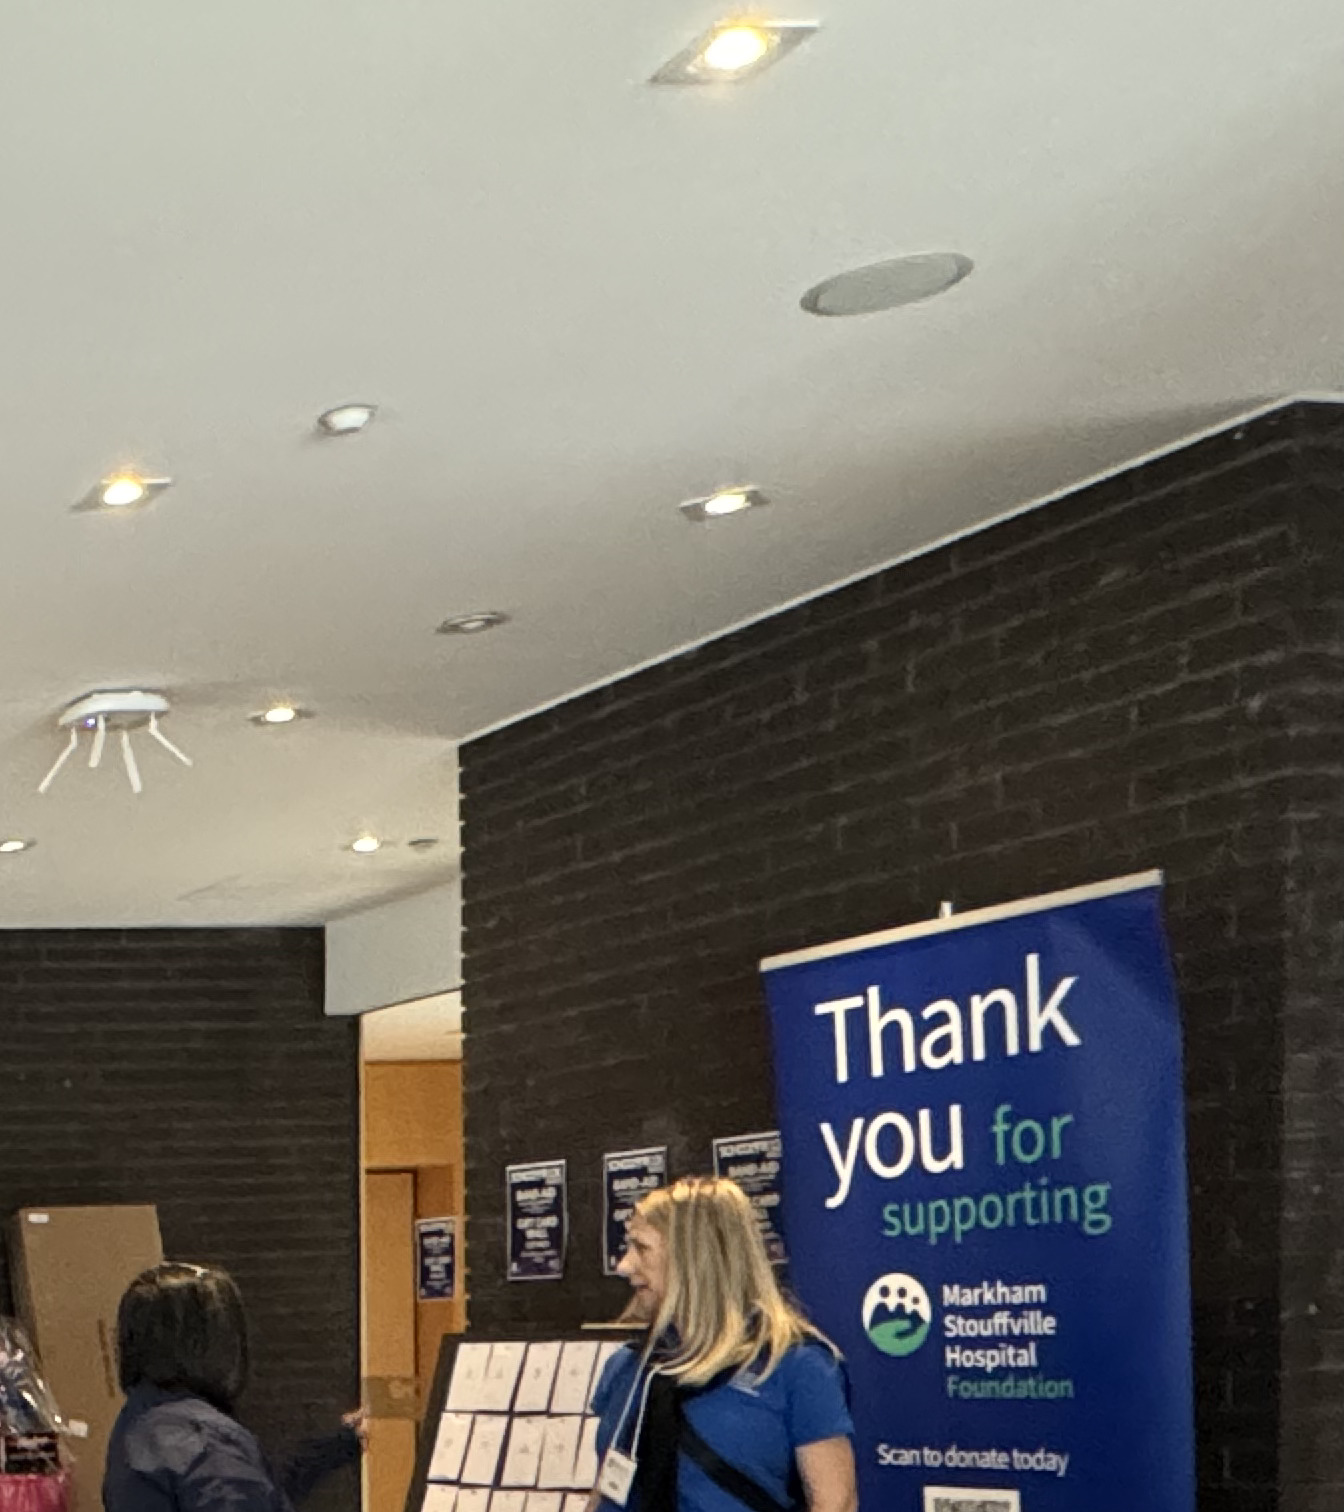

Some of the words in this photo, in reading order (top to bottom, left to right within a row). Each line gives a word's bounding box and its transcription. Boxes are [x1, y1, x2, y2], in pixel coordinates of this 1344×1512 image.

[815, 953, 1082, 1083] Thank
[821, 1104, 965, 1209] you
[991, 1104, 1074, 1165] for
[882, 1177, 1112, 1244] supporting
[942, 1279, 1047, 1307] Markham
[943, 1310, 1057, 1337] Stouffville
[945, 1341, 1038, 1374] Hospital
[947, 1372, 1074, 1399] Foundation
[876, 1443, 922, 1466] Scan
[923, 1446, 943, 1467] to
[944, 1445, 1010, 1469] donate
[1011, 1447, 1070, 1477] today
